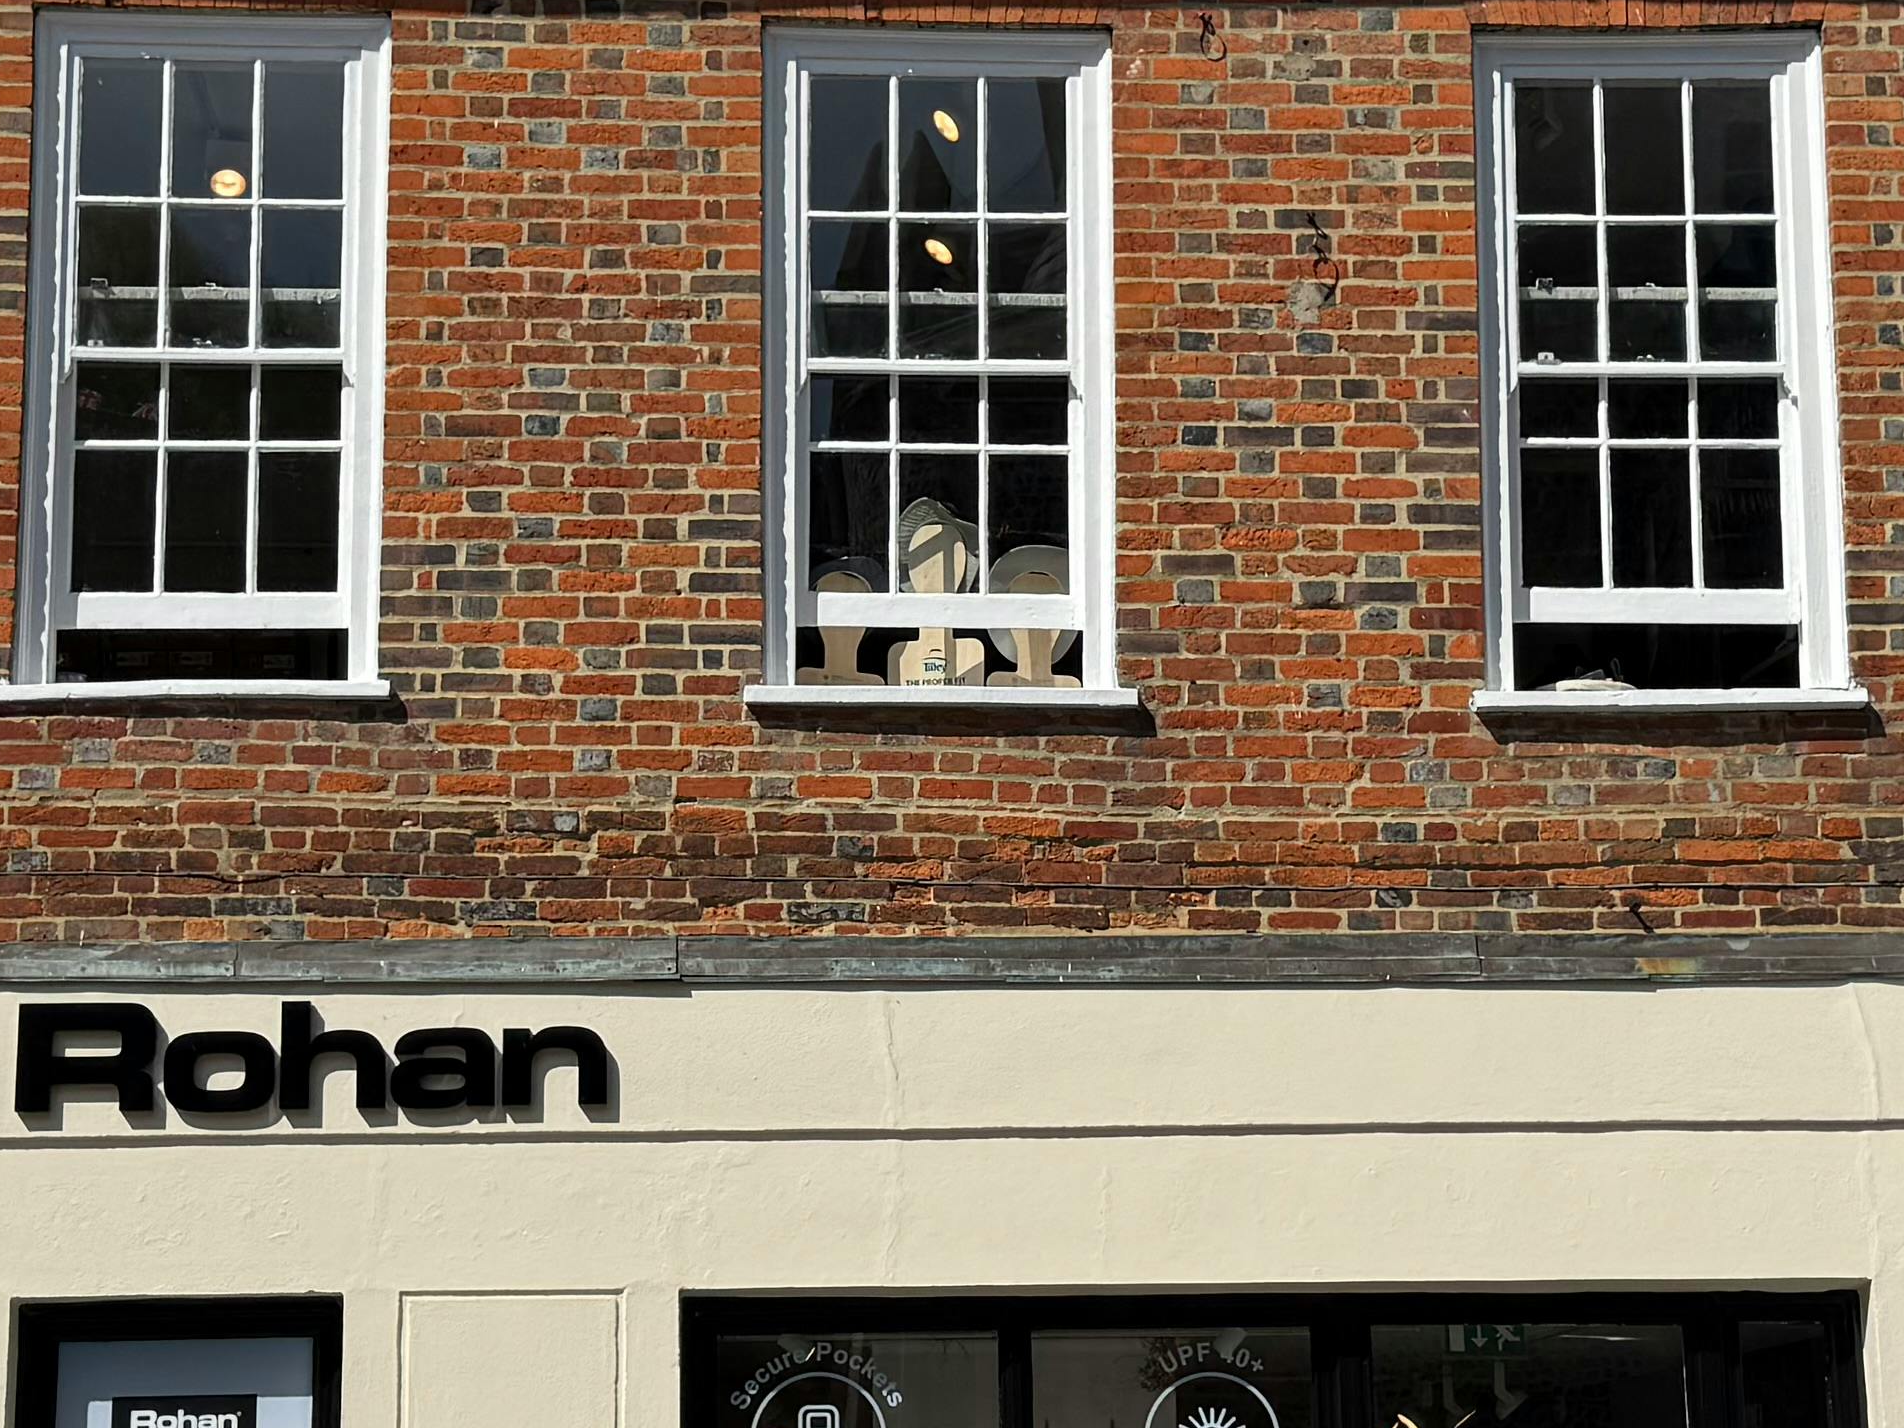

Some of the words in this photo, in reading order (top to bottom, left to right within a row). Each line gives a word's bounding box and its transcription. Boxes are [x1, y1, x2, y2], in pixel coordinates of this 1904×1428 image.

[15, 1001, 608, 1113] Rohan
[730, 1348, 807, 1410] Secure
[816, 1342, 903, 1408] Pockets
[1158, 1342, 1211, 1373] UPF
